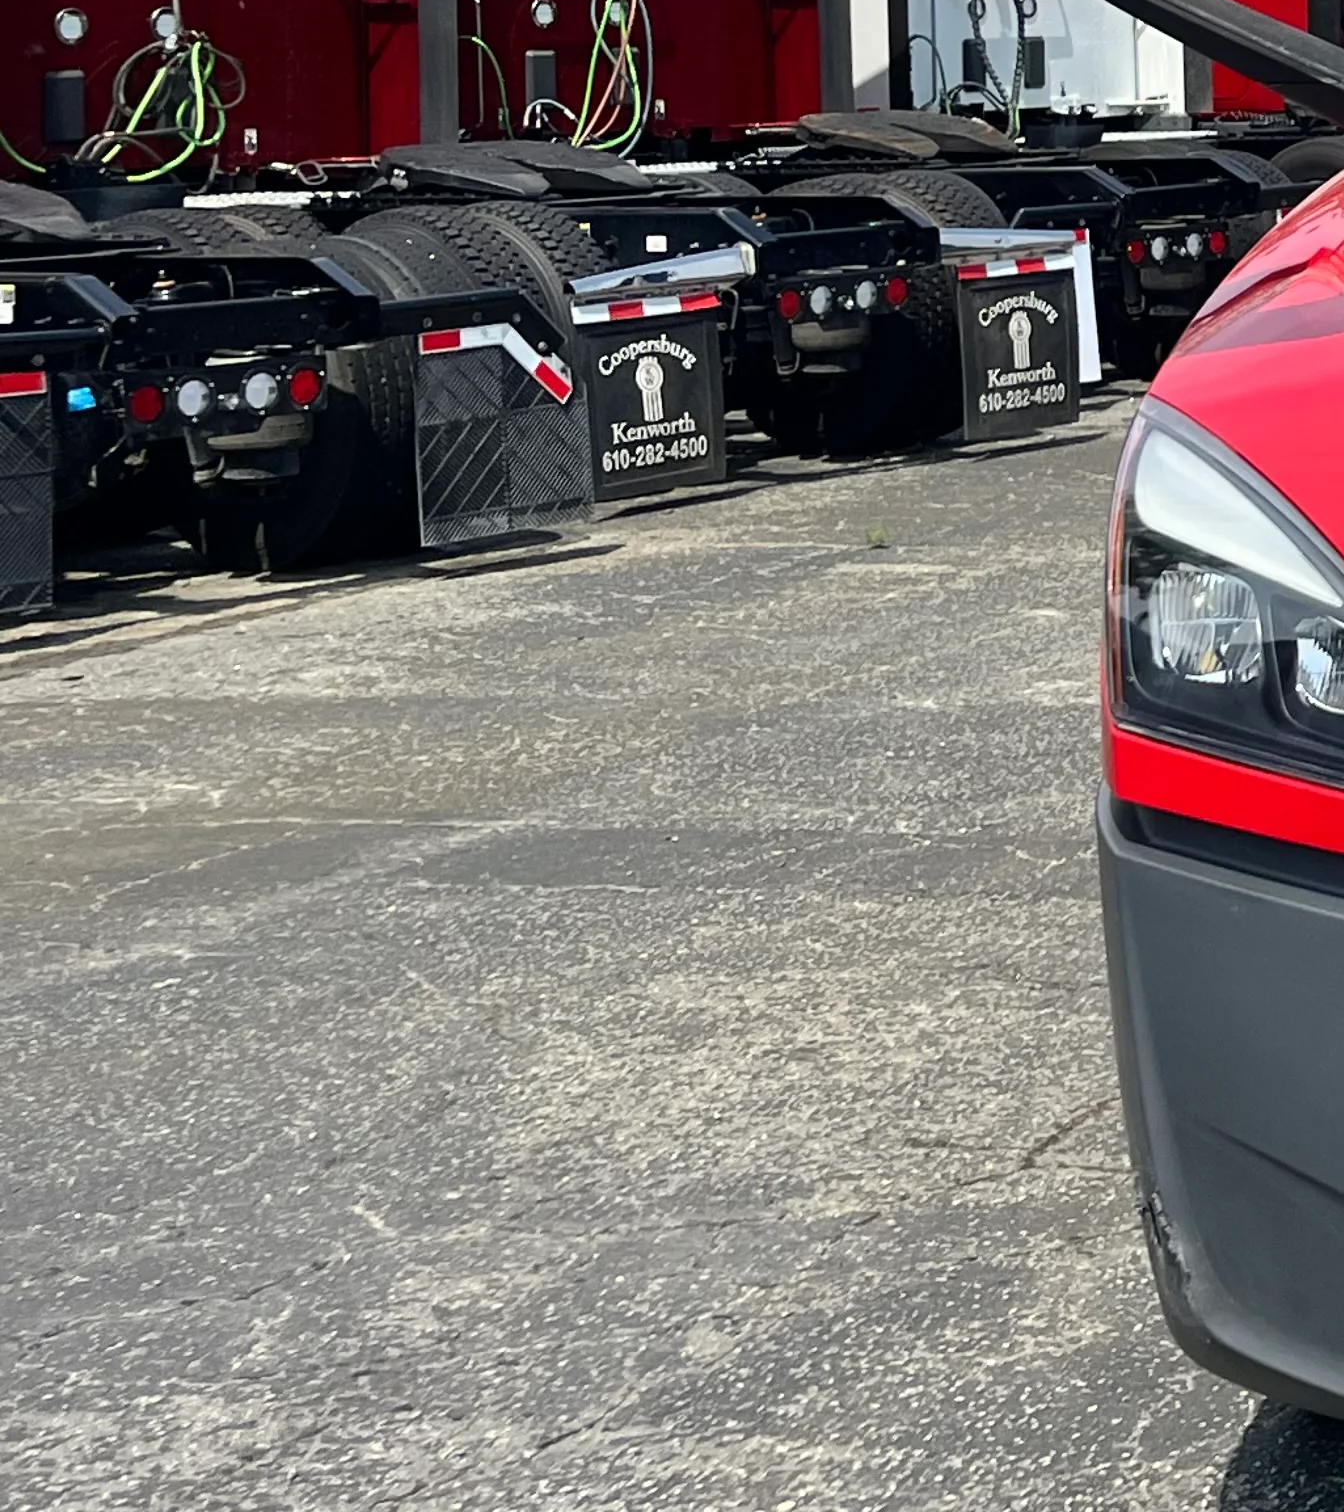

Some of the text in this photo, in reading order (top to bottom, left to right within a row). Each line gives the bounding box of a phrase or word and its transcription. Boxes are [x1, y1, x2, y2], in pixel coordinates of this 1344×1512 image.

[978, 291, 1059, 327] Coopersburg
[599, 334, 697, 376] Coopersburg
[987, 361, 1057, 389] Kenworth
[979, 383, 1065, 414] 610-282-4500
[611, 412, 696, 445] Kenworth
[602, 435, 708, 473] 610-282-4500
